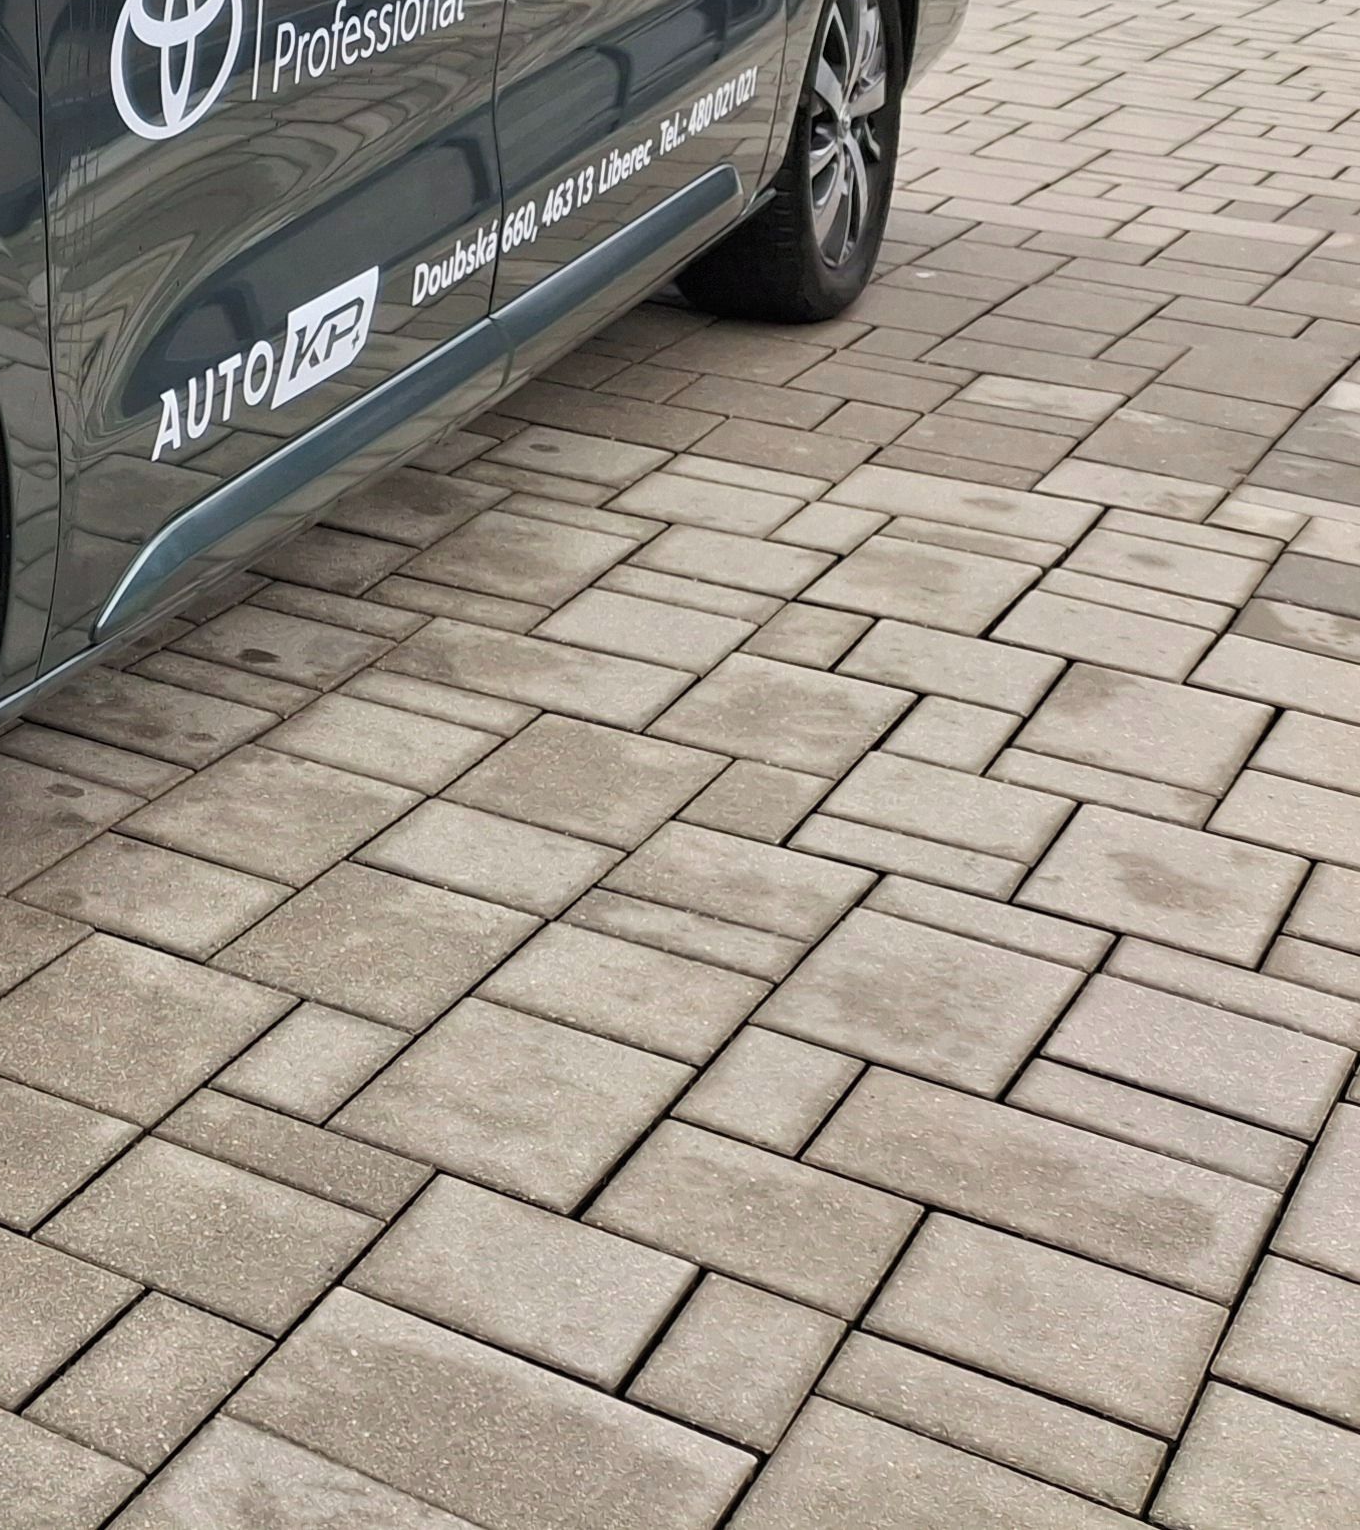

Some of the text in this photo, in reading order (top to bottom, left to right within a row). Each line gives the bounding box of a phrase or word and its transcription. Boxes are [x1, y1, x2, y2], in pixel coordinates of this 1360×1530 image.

[411, 65, 758, 307] Doubská 660, 463 13 Liberec Tel.: 480 021 021
[151, 339, 275, 462] AUTO
